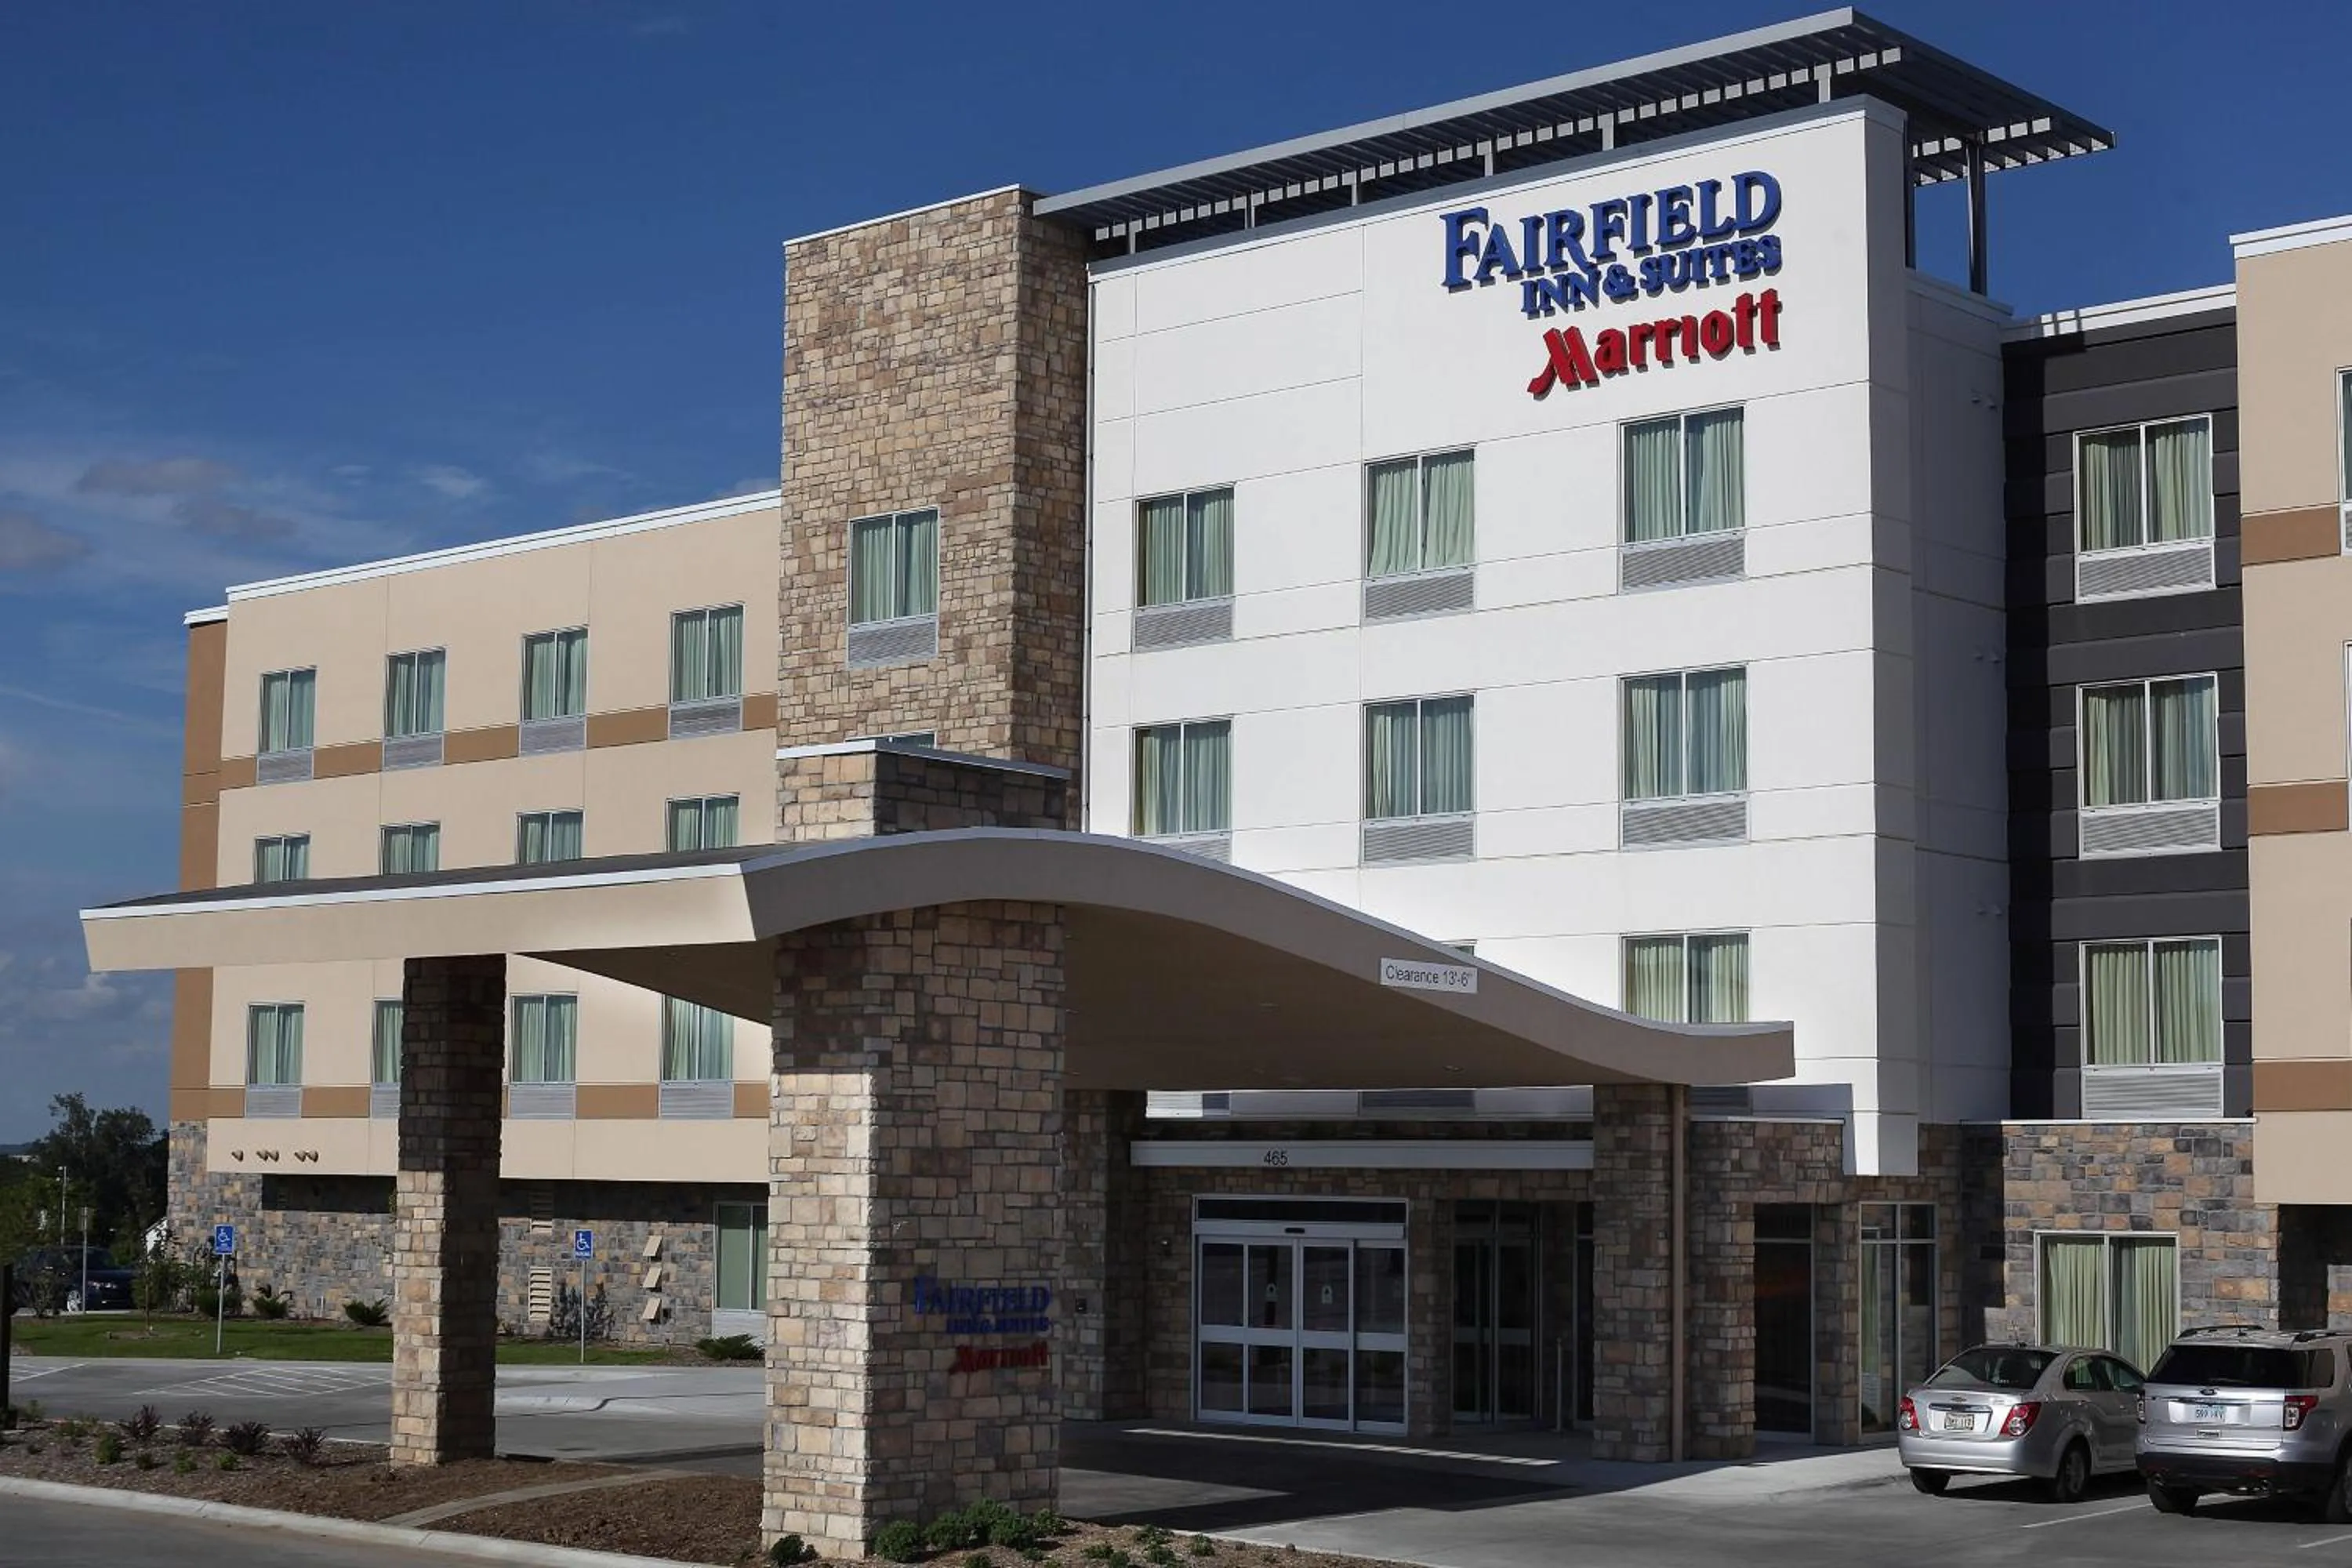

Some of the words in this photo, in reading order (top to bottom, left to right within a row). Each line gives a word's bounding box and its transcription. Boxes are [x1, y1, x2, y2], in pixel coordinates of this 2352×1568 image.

[1439, 170, 1782, 291] FAIRFIELD
[1526, 287, 1782, 395] Marriott
[1385, 964, 1439, 985] Clearance
[1263, 1149, 1288, 1166] 465
